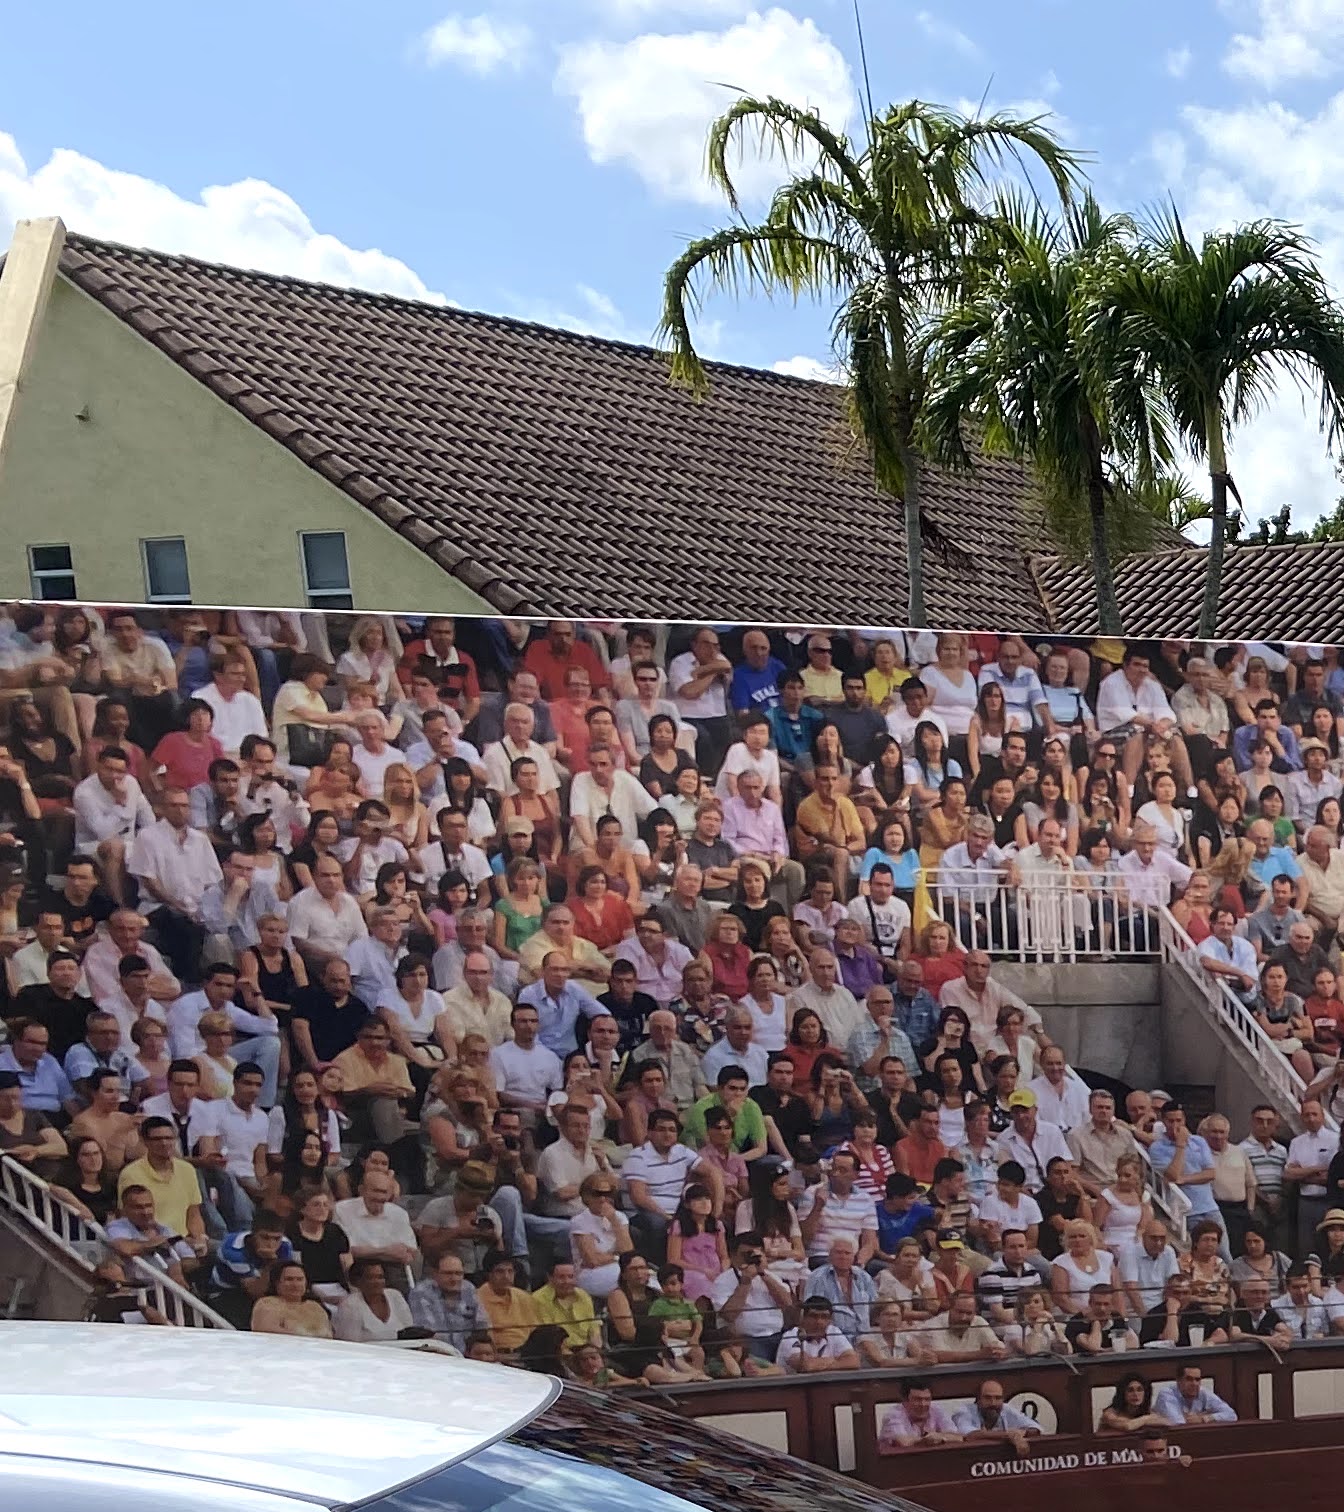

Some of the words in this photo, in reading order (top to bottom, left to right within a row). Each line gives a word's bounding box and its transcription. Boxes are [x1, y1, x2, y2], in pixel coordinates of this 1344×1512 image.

[970, 1453, 1079, 1478] COMUNIDAD
[1084, 1451, 1109, 1467] DE
[1111, 1445, 1182, 1465] MAD
